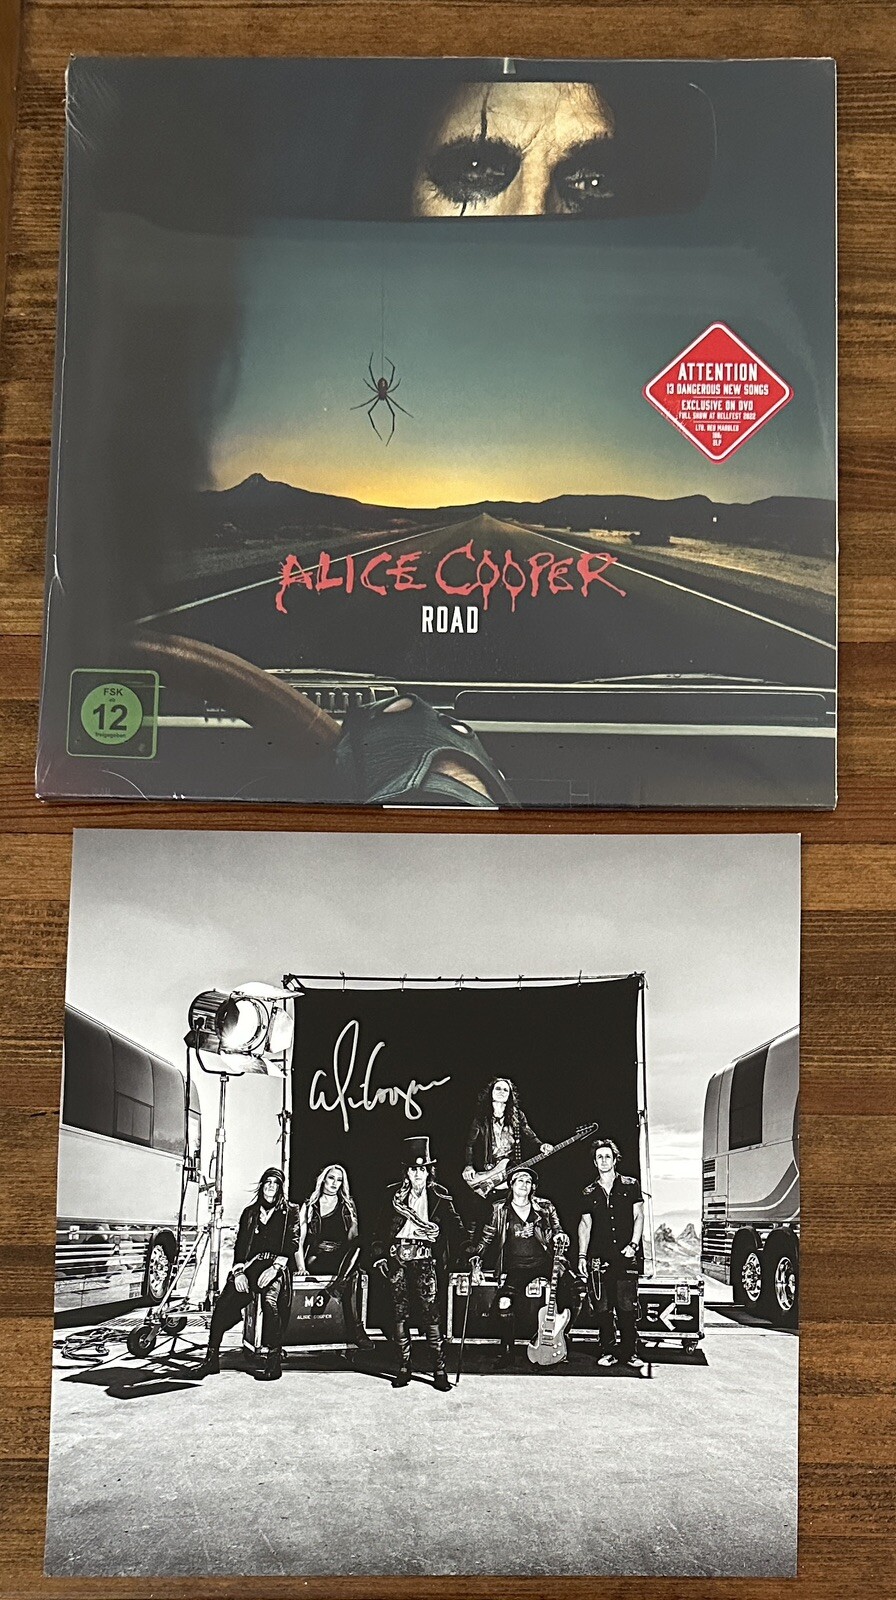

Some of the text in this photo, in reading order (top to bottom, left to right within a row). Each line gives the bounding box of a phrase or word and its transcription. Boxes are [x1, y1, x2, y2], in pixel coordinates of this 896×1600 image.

[678, 363, 758, 381] ATTENTION
[667, 384, 769, 396] 13 DANGEROUS NEW SONGS
[682, 400, 753, 411] EXCLUSIVE ON DVD
[275, 539, 626, 614] ALICE COOPER
[422, 606, 479, 634] ROAD
[104, 688, 124, 696] FSK
[93, 704, 128, 731] 12
